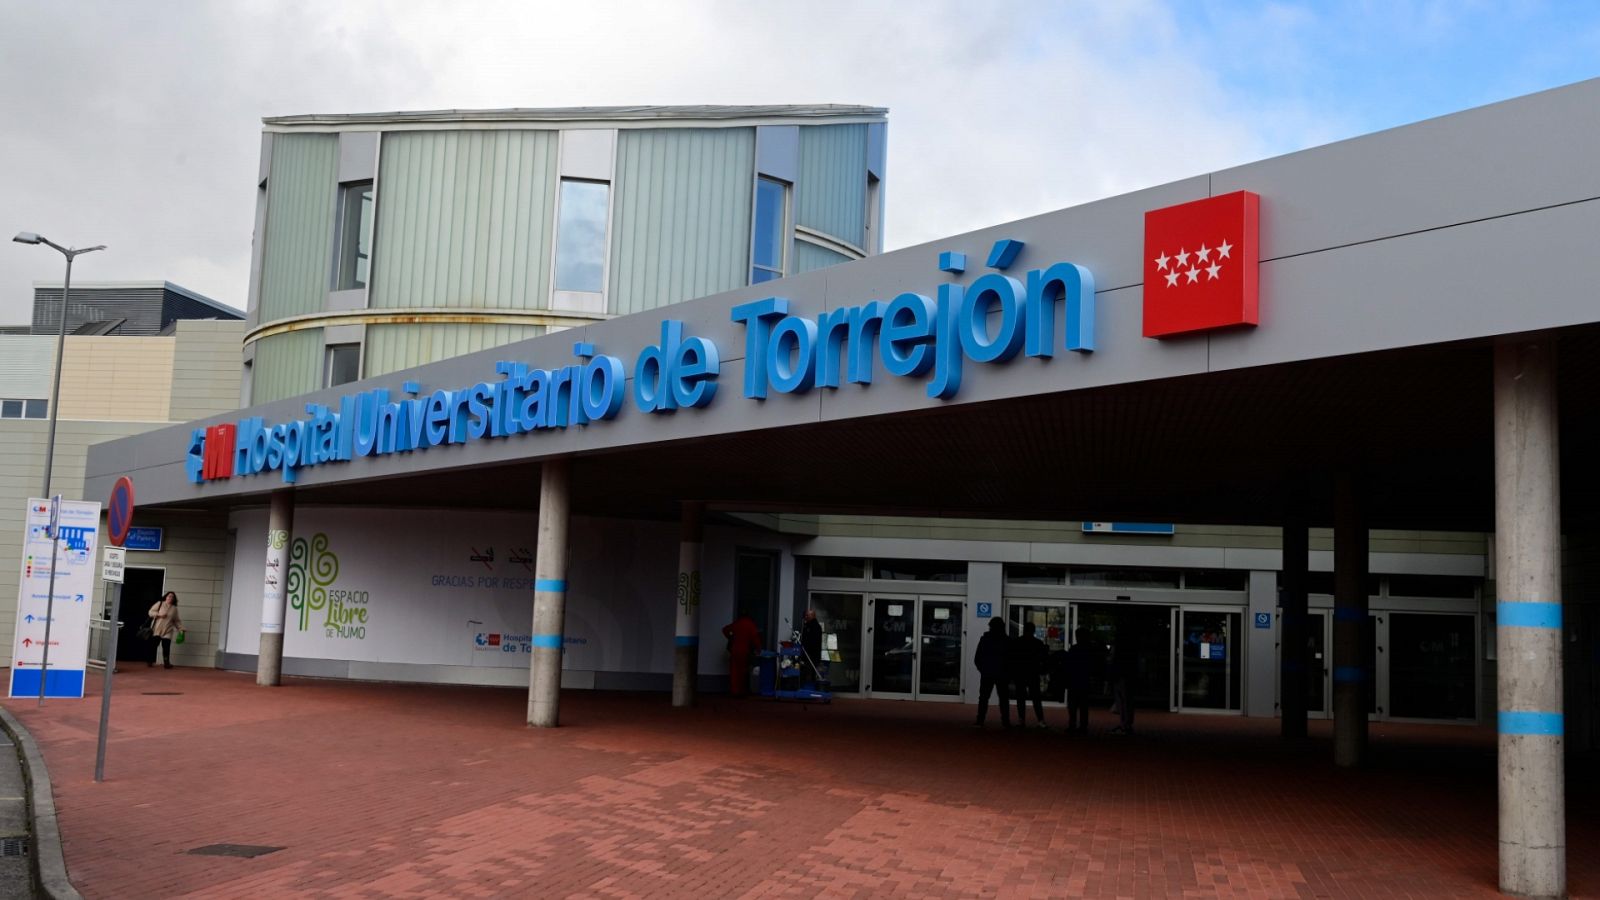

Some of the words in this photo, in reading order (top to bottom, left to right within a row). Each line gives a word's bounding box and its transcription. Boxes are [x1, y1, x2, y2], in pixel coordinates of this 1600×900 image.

[234, 396, 352, 483] Hospital
[354, 343, 625, 456] Universitario
[634, 320, 720, 413] de
[731, 239, 1095, 399] Torrejón
[432, 575, 474, 588] GRACIAS
[478, 576, 498, 588] POR
[329, 590, 369, 604] ESPACIO
[324, 600, 368, 631] Libre
[326, 628, 334, 638] DE
[336, 626, 366, 639] HUMO
[503, 633, 533, 643] Hospita
[502, 642, 516, 653] de
